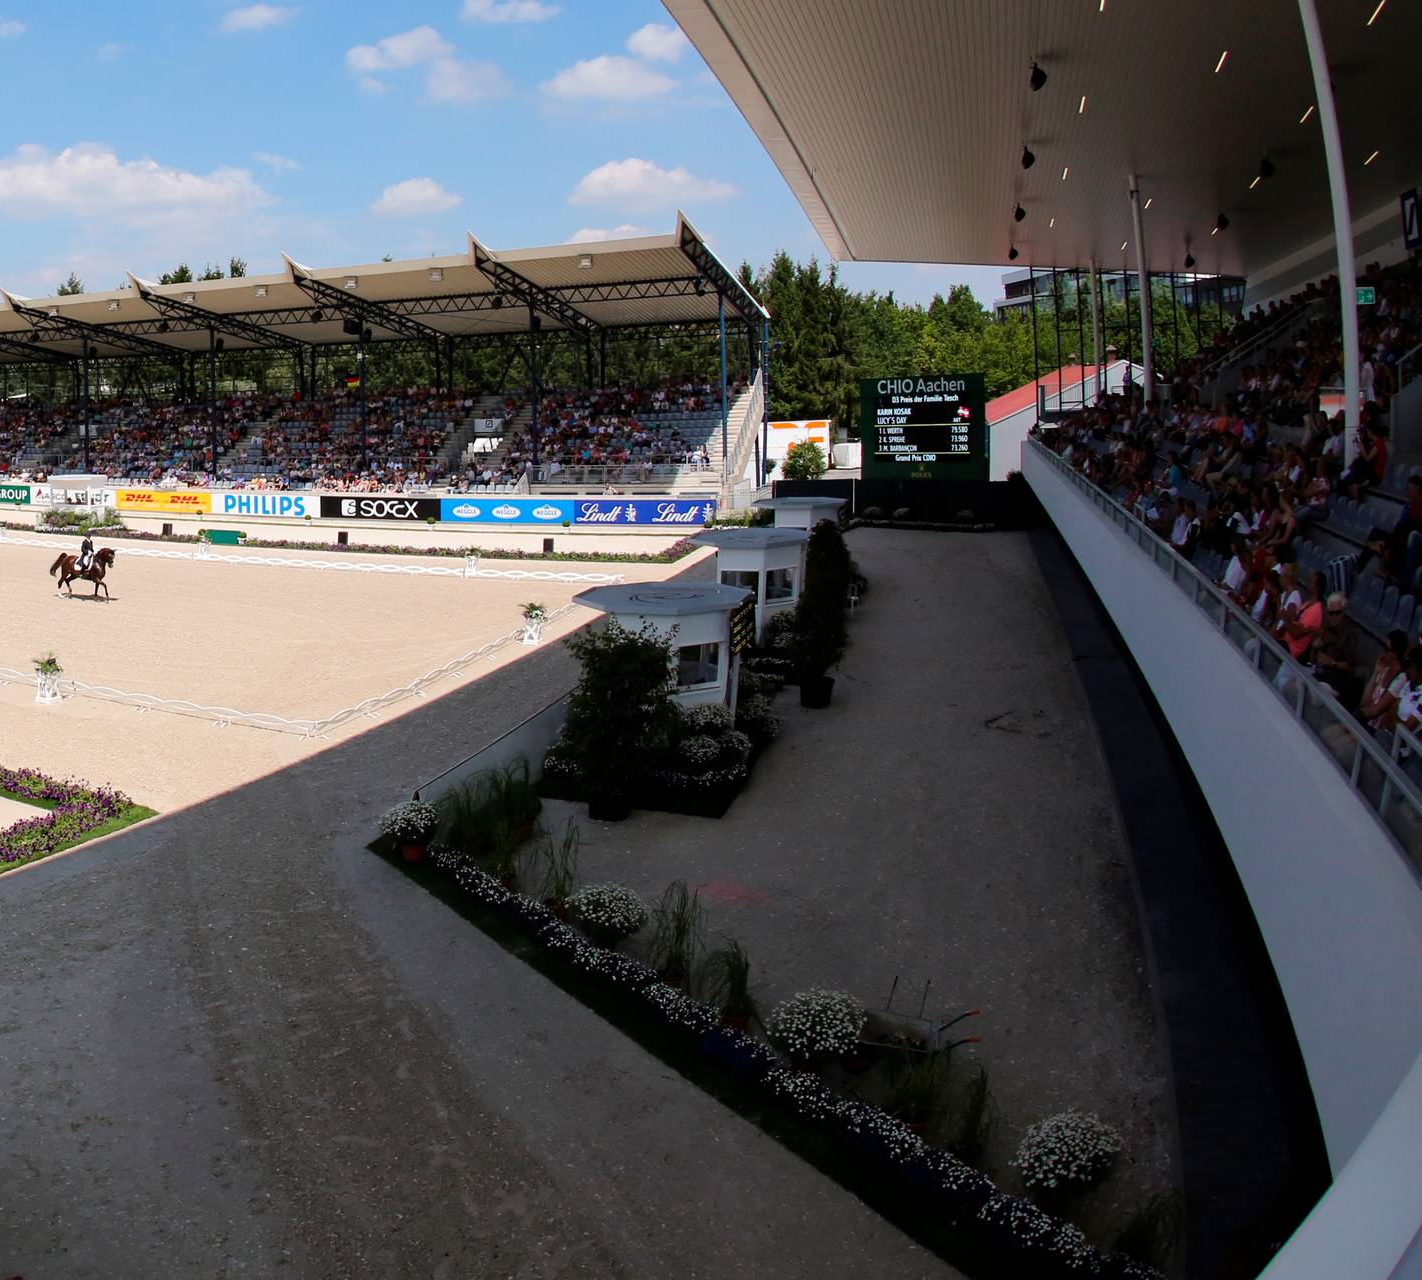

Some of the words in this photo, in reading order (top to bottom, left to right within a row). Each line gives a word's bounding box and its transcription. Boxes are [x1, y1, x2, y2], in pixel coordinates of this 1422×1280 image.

[877, 379, 913, 394] CHIO
[916, 377, 965, 392] Aachen
[125, 494, 154, 503] DHL
[170, 496, 199, 504] DHL
[224, 495, 305, 516] PHILIPS
[577, 503, 622, 522] Lindt
[652, 503, 699, 522] Lindt
